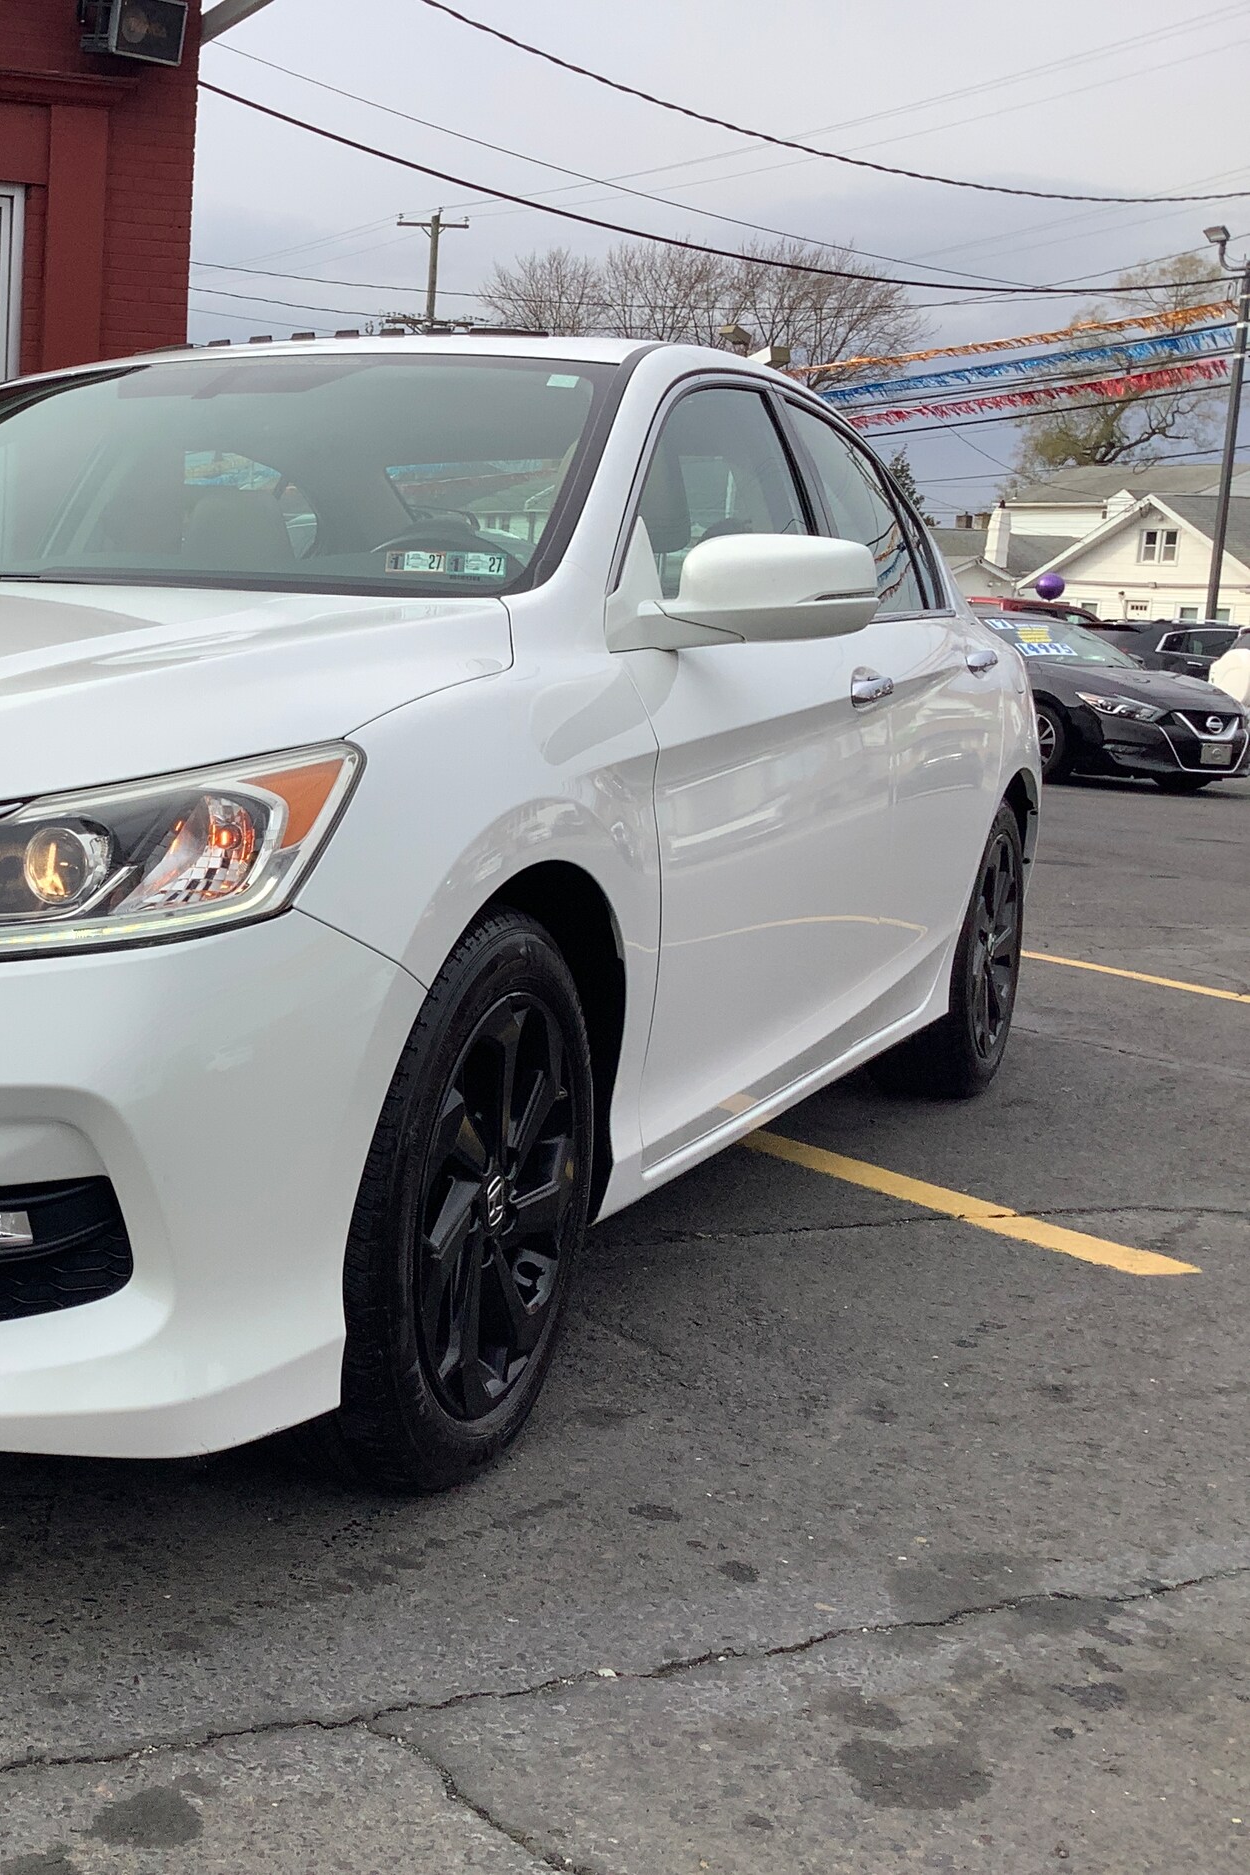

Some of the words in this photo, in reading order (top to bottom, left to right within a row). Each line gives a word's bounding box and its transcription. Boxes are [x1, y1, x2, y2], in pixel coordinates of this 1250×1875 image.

[428, 554, 442, 570] 27
[488, 556, 503, 573] 27
[1017, 643, 1074, 654] 14995
